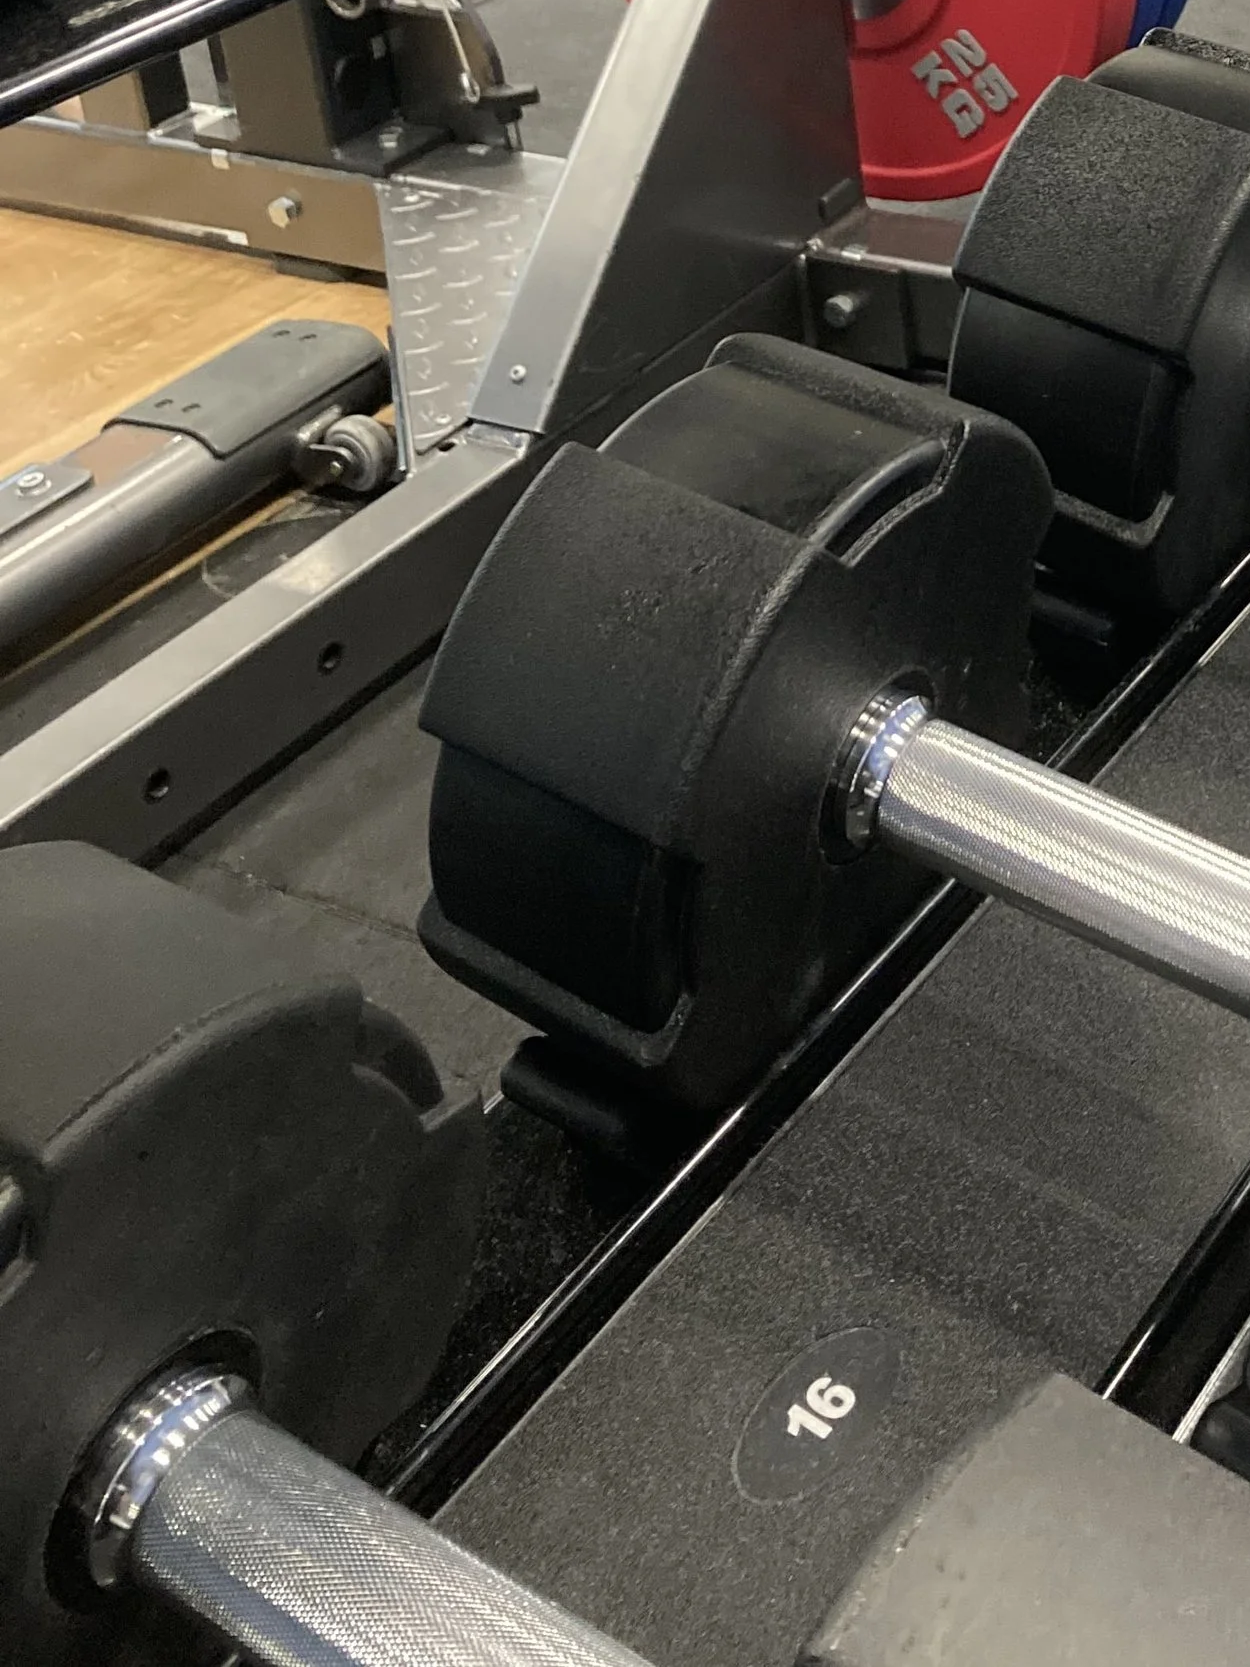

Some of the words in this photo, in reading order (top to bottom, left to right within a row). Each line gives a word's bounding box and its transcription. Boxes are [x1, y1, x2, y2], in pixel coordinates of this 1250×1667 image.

[911, 51, 987, 139] KG
[941, 28, 1020, 115] 25
[787, 1376, 857, 1440] 16
